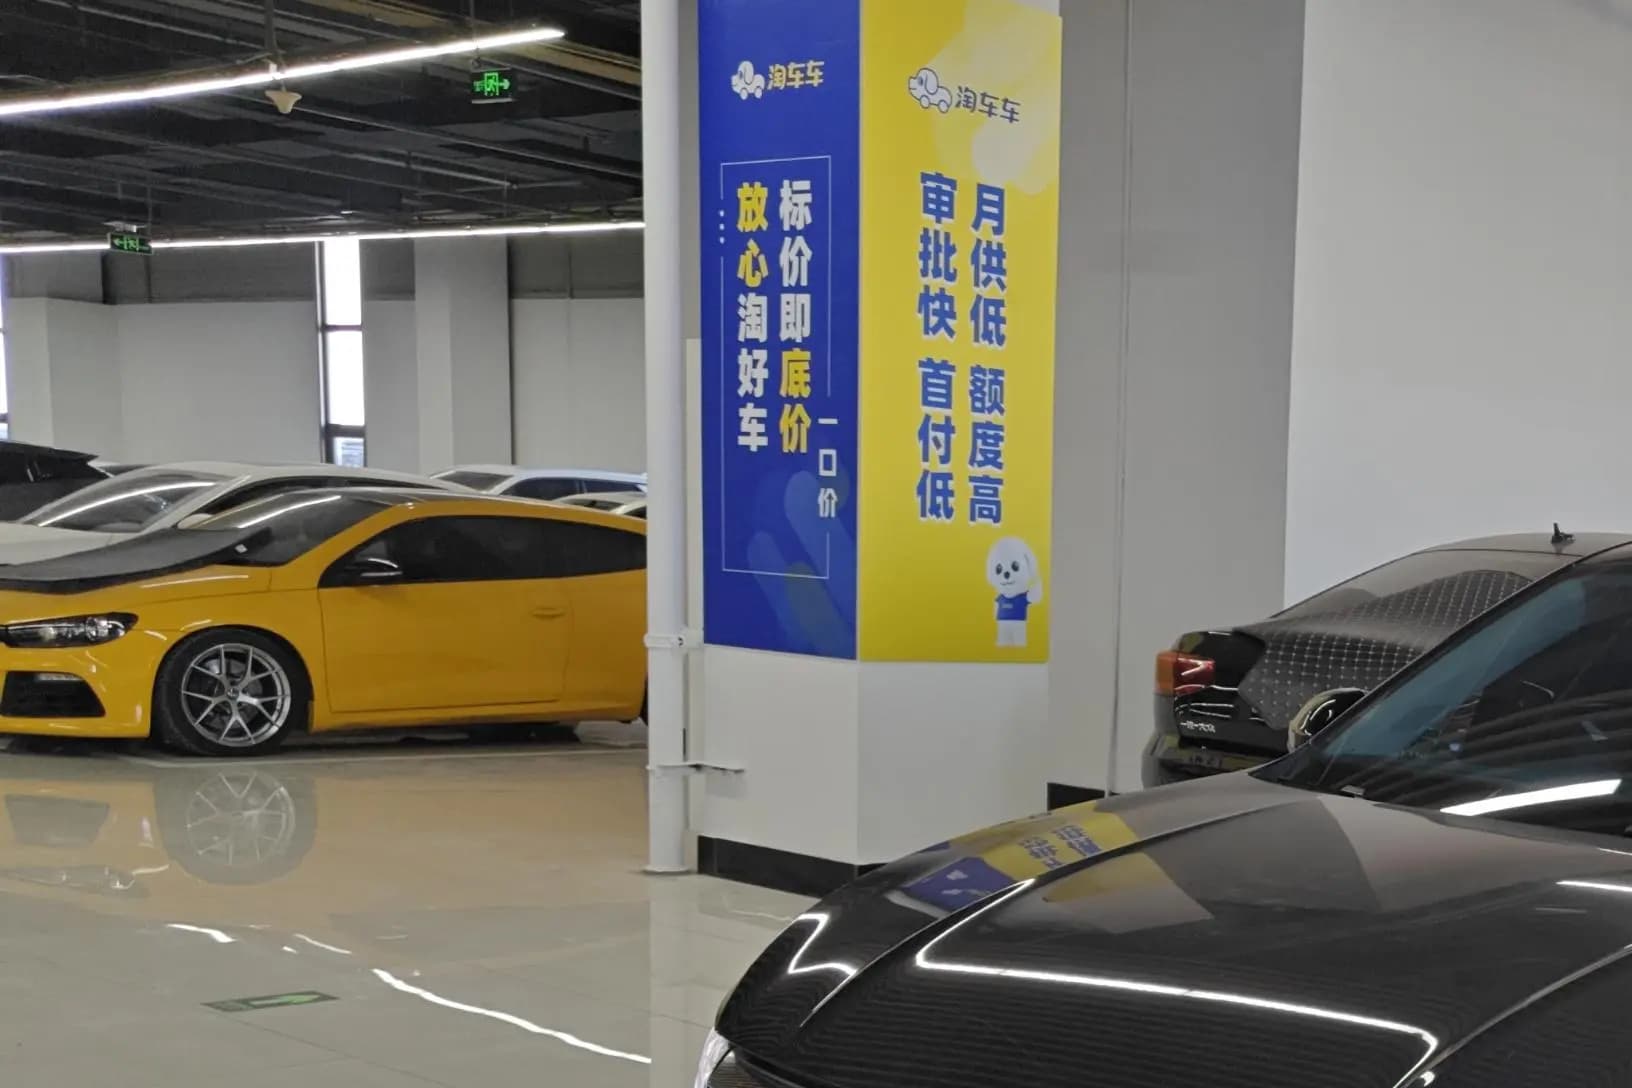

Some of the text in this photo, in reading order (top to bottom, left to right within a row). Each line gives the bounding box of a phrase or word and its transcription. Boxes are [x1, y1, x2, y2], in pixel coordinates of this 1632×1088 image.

[767, 60, 824, 91] 淘车车
[955, 86, 1021, 123] 淘车车
[737, 182, 769, 452] 放心淘好车
[779, 179, 812, 454] 标价即底价
[818, 417, 838, 518] 一口价
